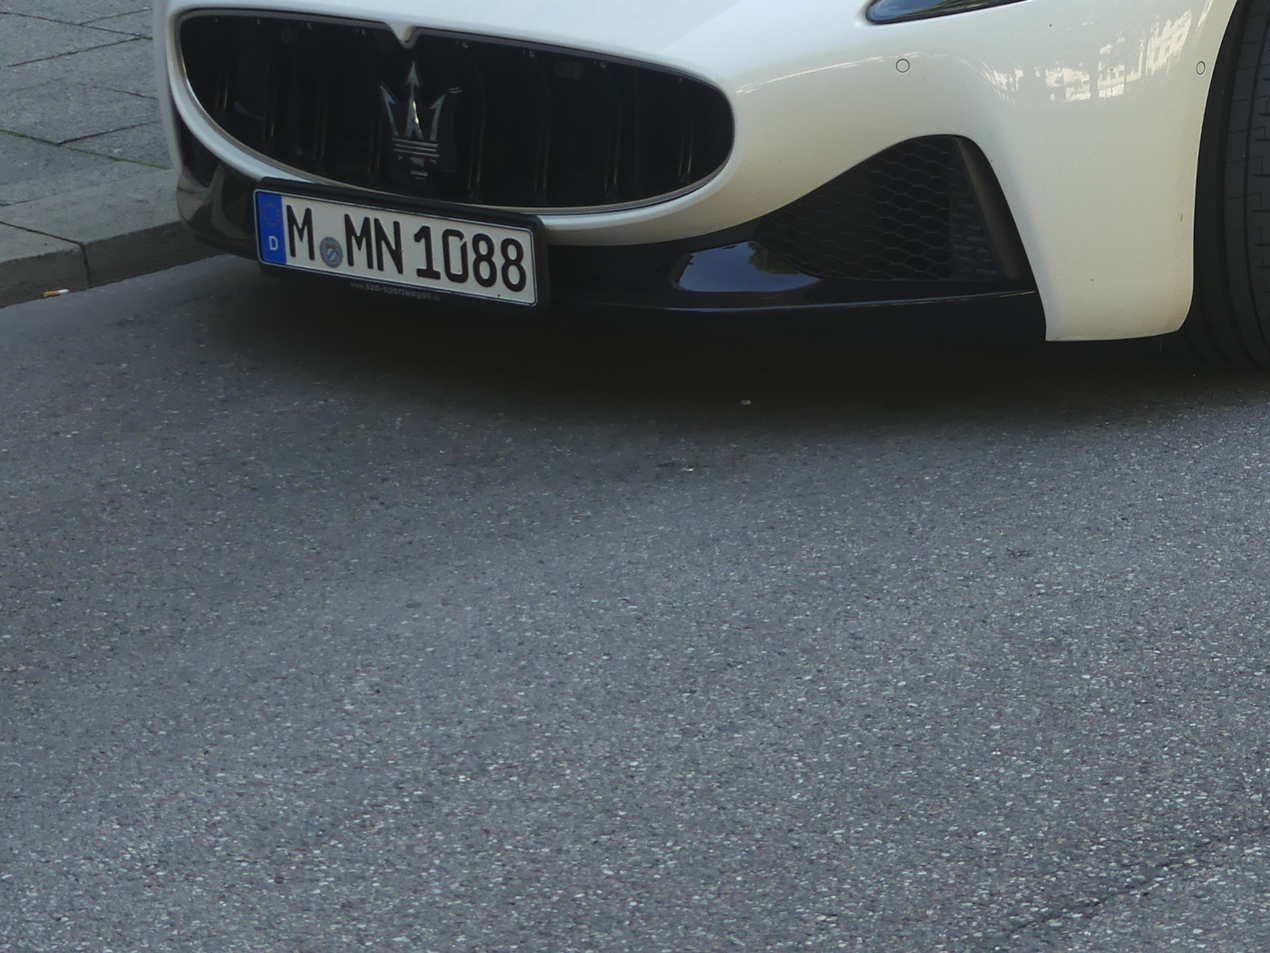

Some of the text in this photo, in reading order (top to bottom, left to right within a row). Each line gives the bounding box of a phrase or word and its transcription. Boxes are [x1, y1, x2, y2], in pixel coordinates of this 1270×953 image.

[269, 235, 279, 251] D
[286, 204, 527, 293] M MN 1088
